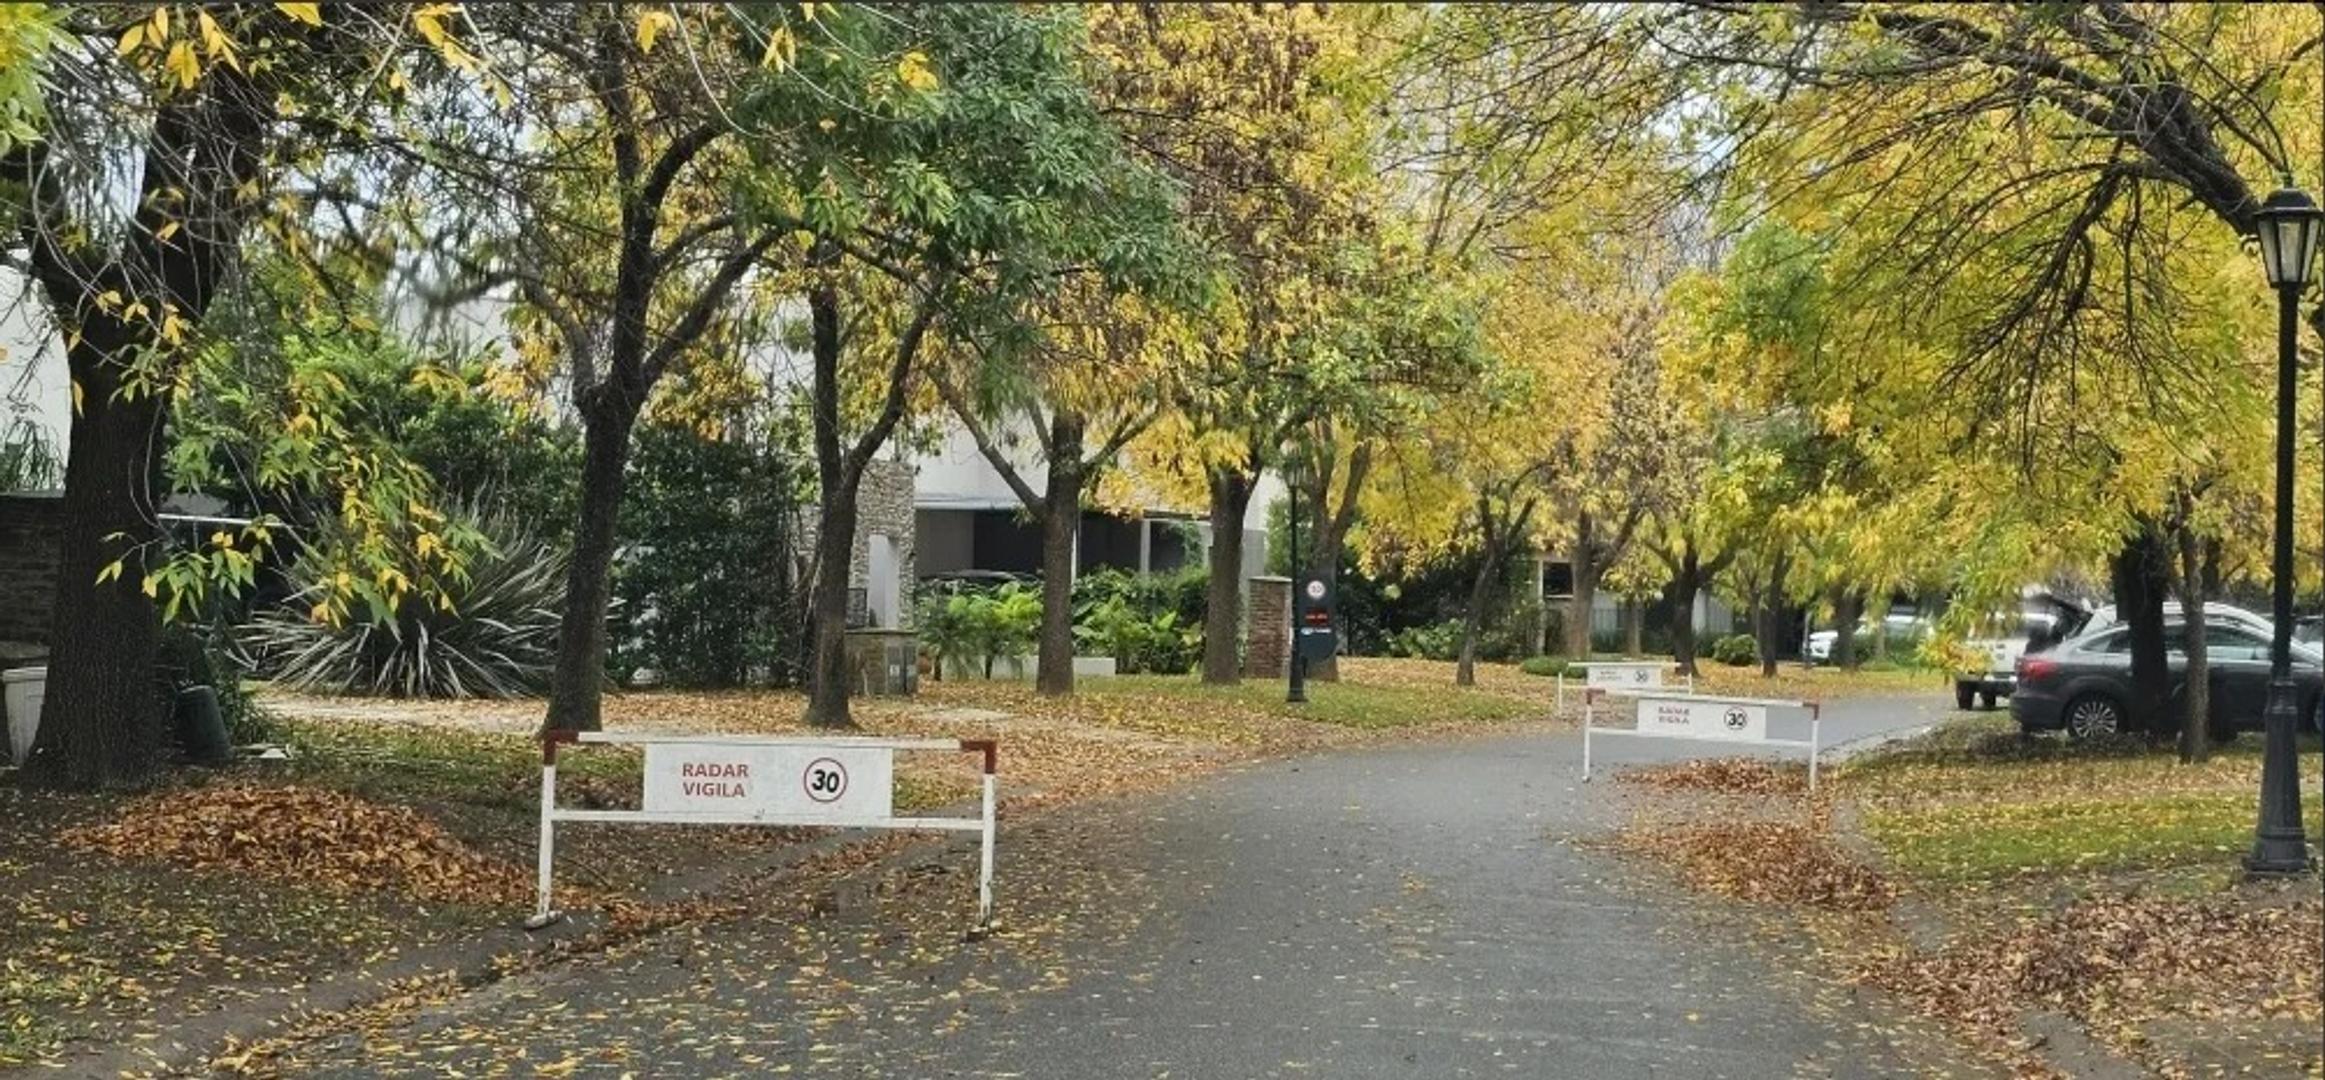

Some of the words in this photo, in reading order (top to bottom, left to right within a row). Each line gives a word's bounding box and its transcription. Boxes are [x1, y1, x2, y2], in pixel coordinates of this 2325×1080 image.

[1728, 713, 1746, 726] 30
[682, 763, 749, 777] RADAR
[812, 769, 840, 793] 30
[683, 782, 746, 798] VIGILA
